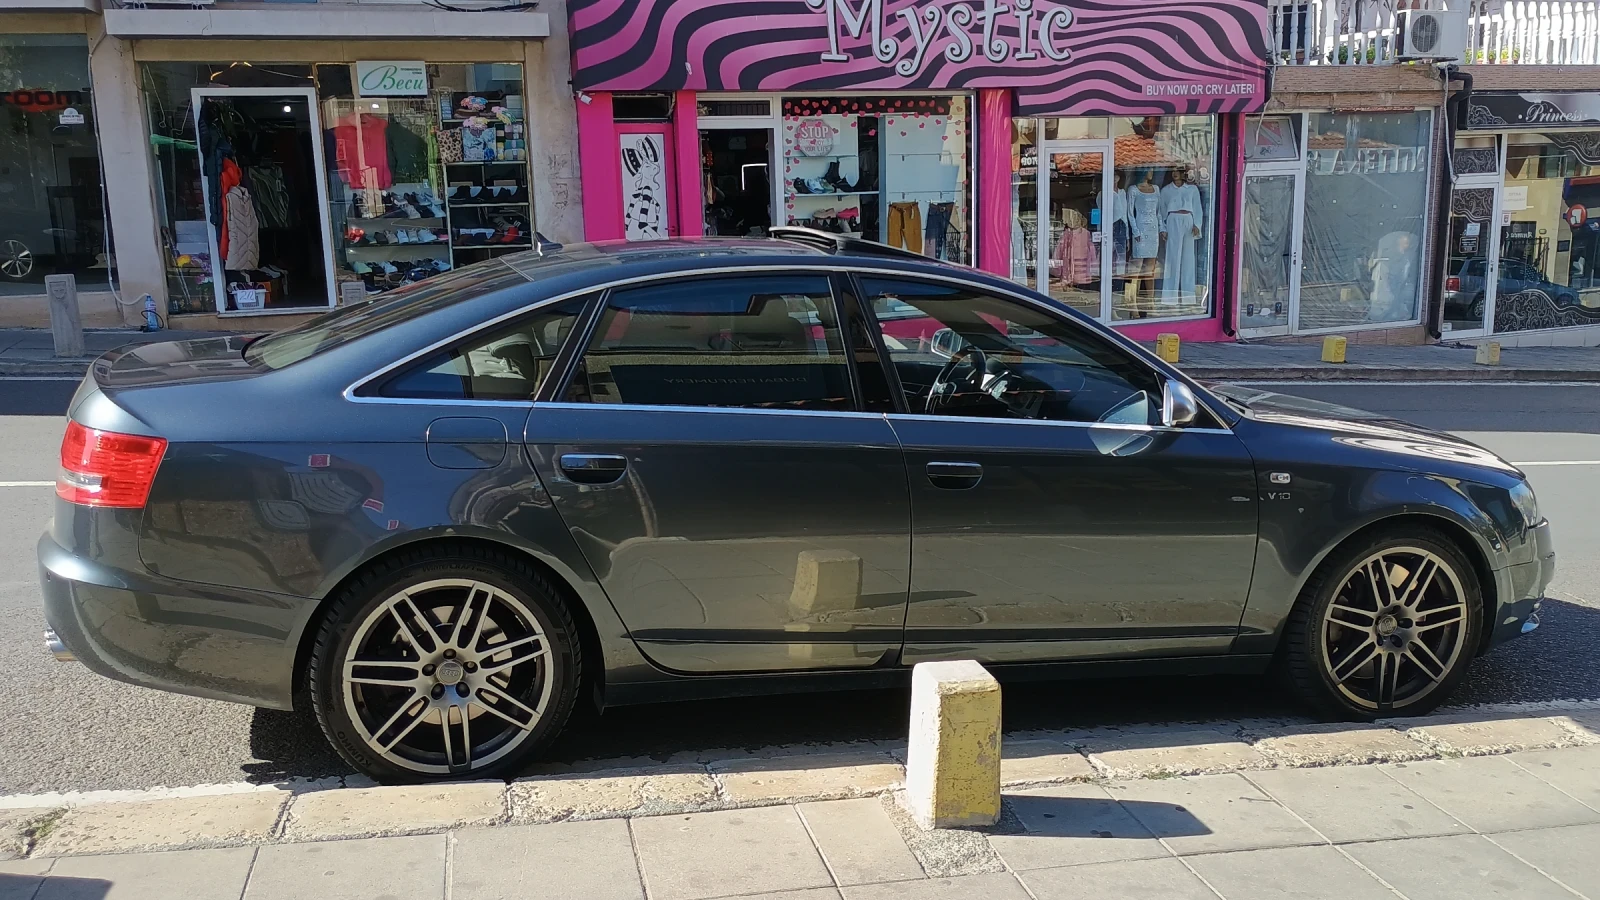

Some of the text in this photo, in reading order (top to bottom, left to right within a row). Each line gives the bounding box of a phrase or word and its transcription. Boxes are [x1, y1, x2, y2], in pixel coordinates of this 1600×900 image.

[806, 0, 1072, 76] Mystic
[1146, 83, 1255, 96] BUY NOW OR CRY LATER!
[1526, 103, 1582, 123] Princess
[801, 126, 829, 139] STOP
[1268, 492, 1291, 500] V10
[337, 731, 371, 768] KUMHO
